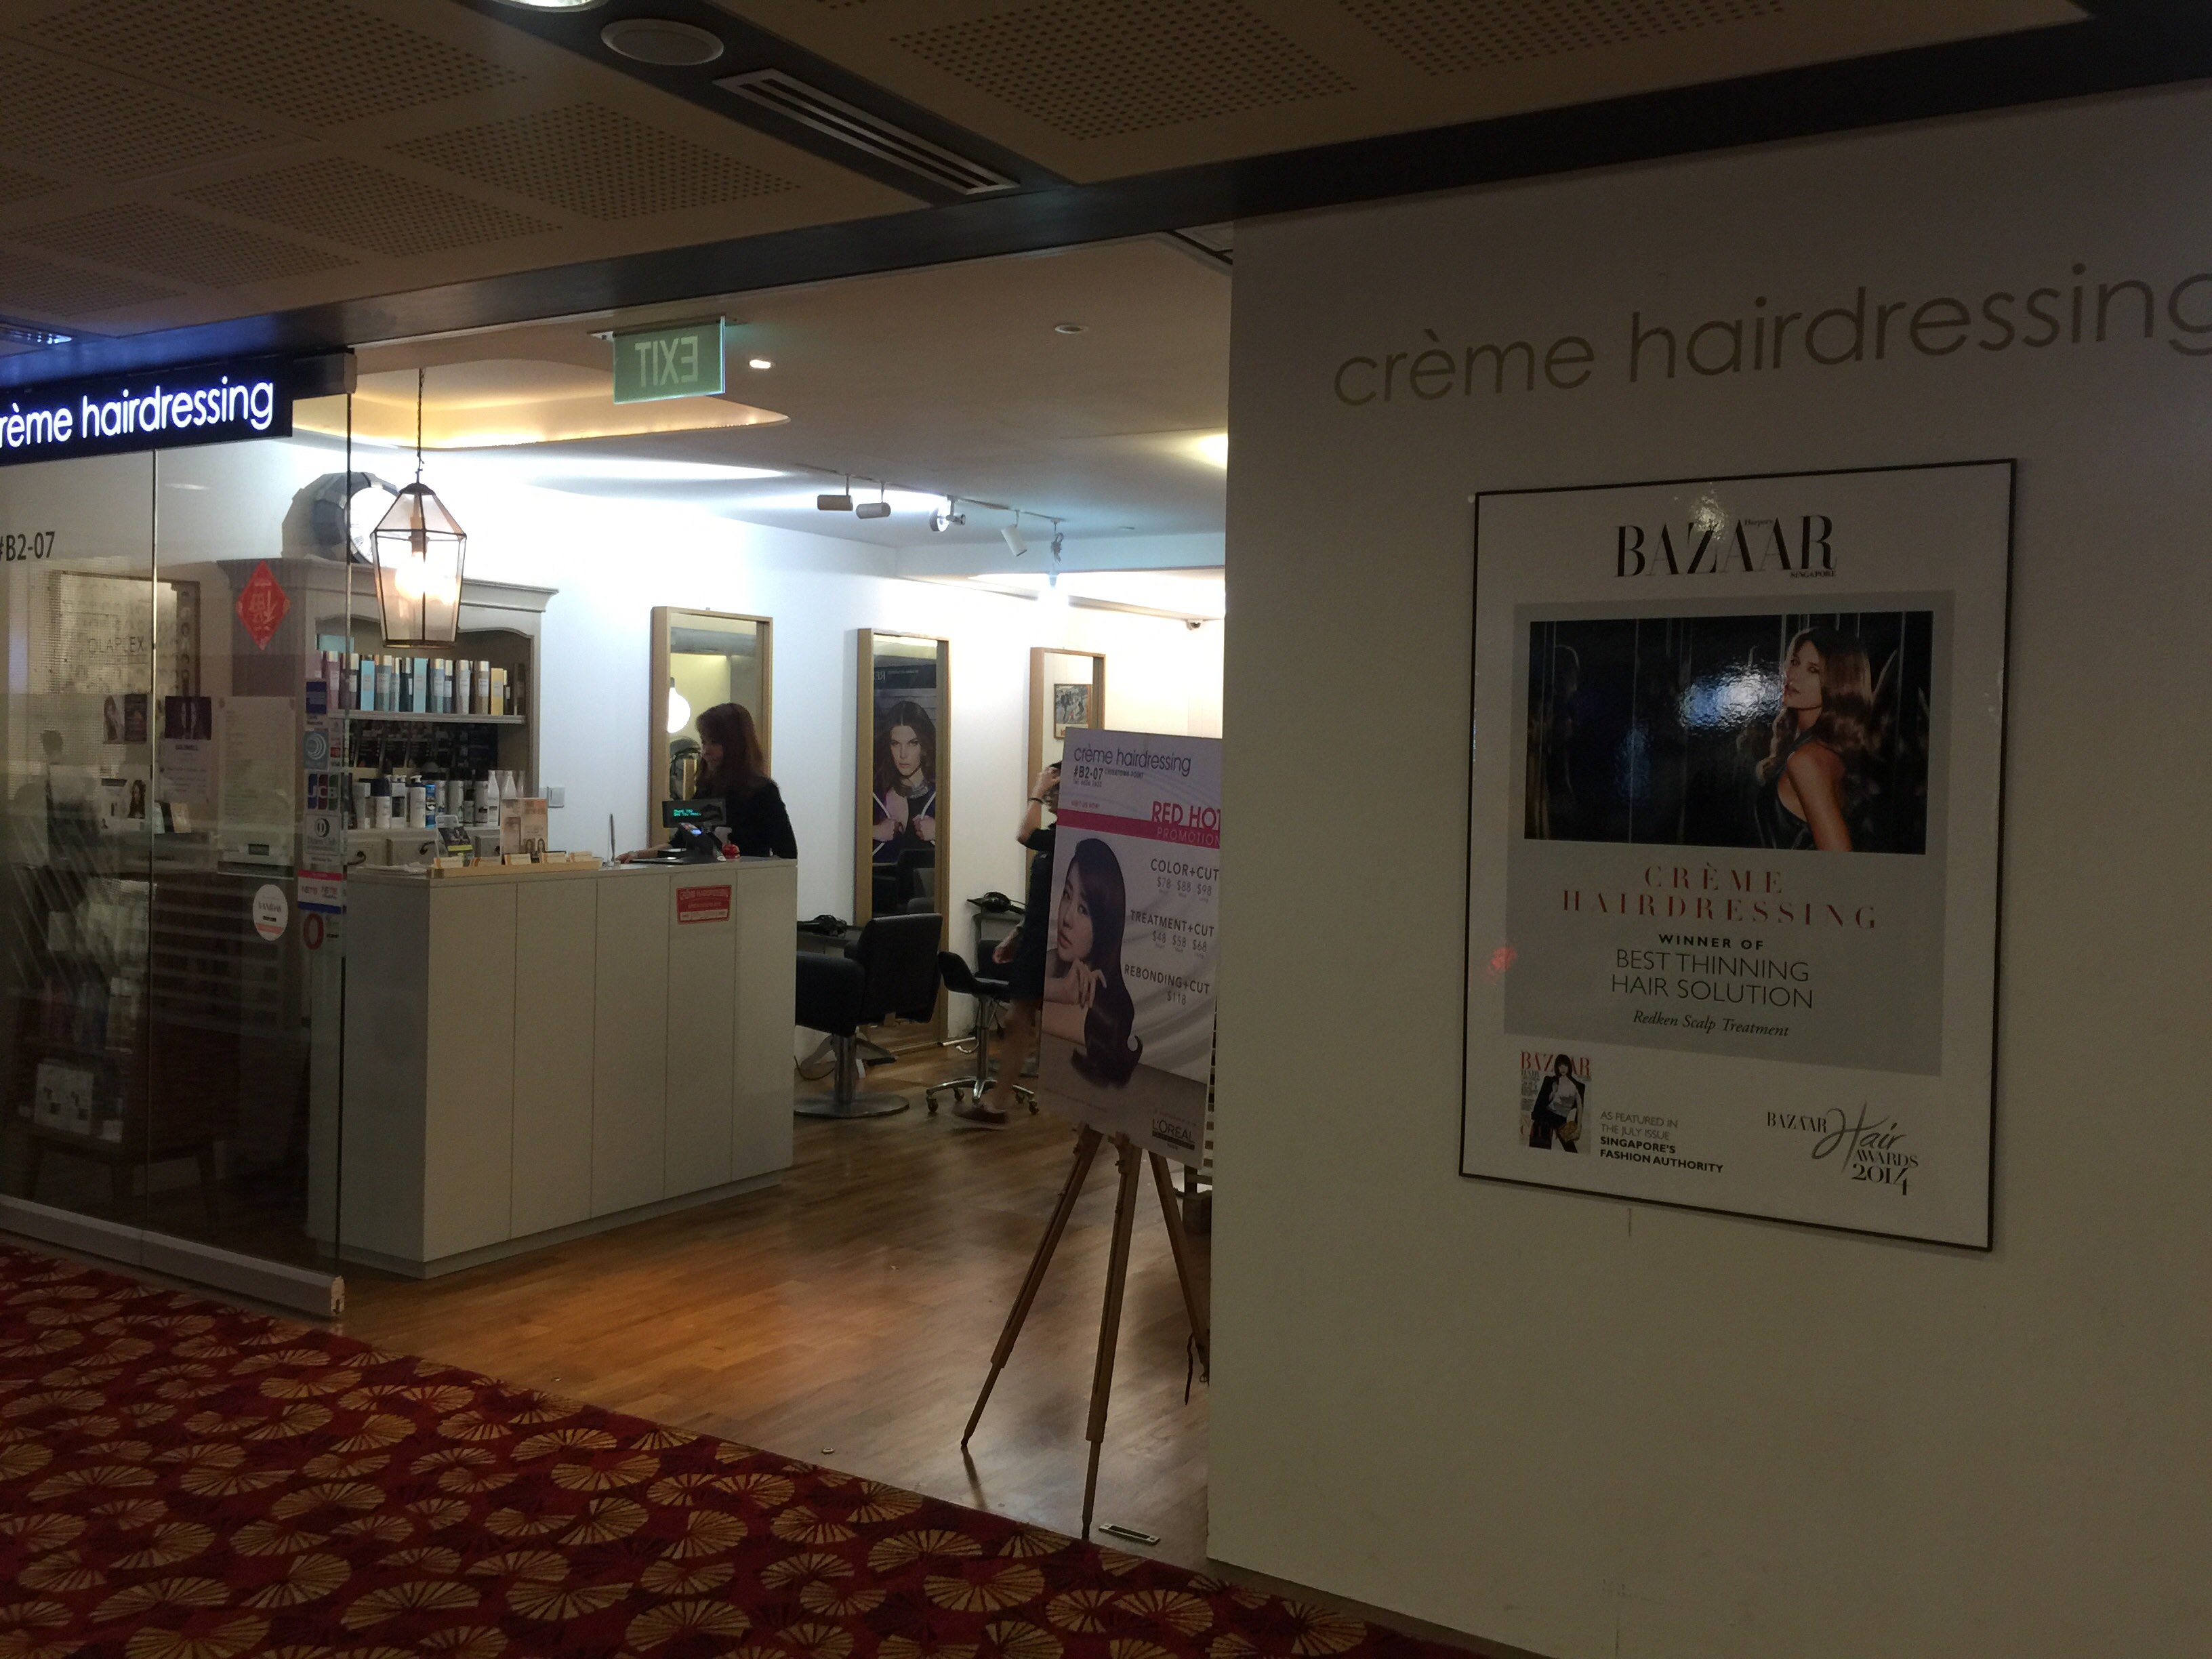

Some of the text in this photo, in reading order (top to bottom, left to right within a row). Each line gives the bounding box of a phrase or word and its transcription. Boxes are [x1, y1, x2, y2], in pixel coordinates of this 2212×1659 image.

[1334, 262, 2212, 407] crème hairdressing
[0, 375, 273, 448] rème hairdressing
[0, 531, 56, 562] #B2-07
[1614, 514, 1838, 577] BAZAAR
[1073, 765, 1103, 780] #B2-07
[1074, 743, 1191, 777] crème hairdressing
[308, 785, 337, 798] JCB
[1152, 800, 1221, 830] RED HOT
[1151, 858, 1219, 881] COLOR+CUT
[1645, 862, 1783, 894] CRÈME
[1177, 880, 1191, 893] $88
[1197, 883, 1212, 896] $98
[1563, 889, 1876, 929] HAIRDRESSING
[1130, 909, 1214, 938] TREATMENT+CUT
[1659, 934, 1764, 950] WINNER OF
[1124, 964, 1210, 995] REBONDING+CUT
[1617, 949, 1809, 983] BEST THINNING
[1167, 991, 1186, 1006] $118
[1612, 974, 1813, 1009] HAIR SOLUTION
[1633, 1010, 1790, 1037] Redken Scalp Treatment
[1520, 1050, 1592, 1076] BAZAR
[1600, 1111, 1678, 1128] AS FEATURED IN
[1601, 1123, 1670, 1141] THE JULY ISSUE
[1767, 1111, 1827, 1133] BAZAAR
[1600, 1136, 1676, 1154] SINGAPORE'S
[1811, 1101, 1908, 1173] Hair
[1600, 1149, 1723, 1173] FASHION AUTHORITY
[1855, 1149, 1919, 1168] AWARDS
[1851, 1163, 1909, 1195] 2014
